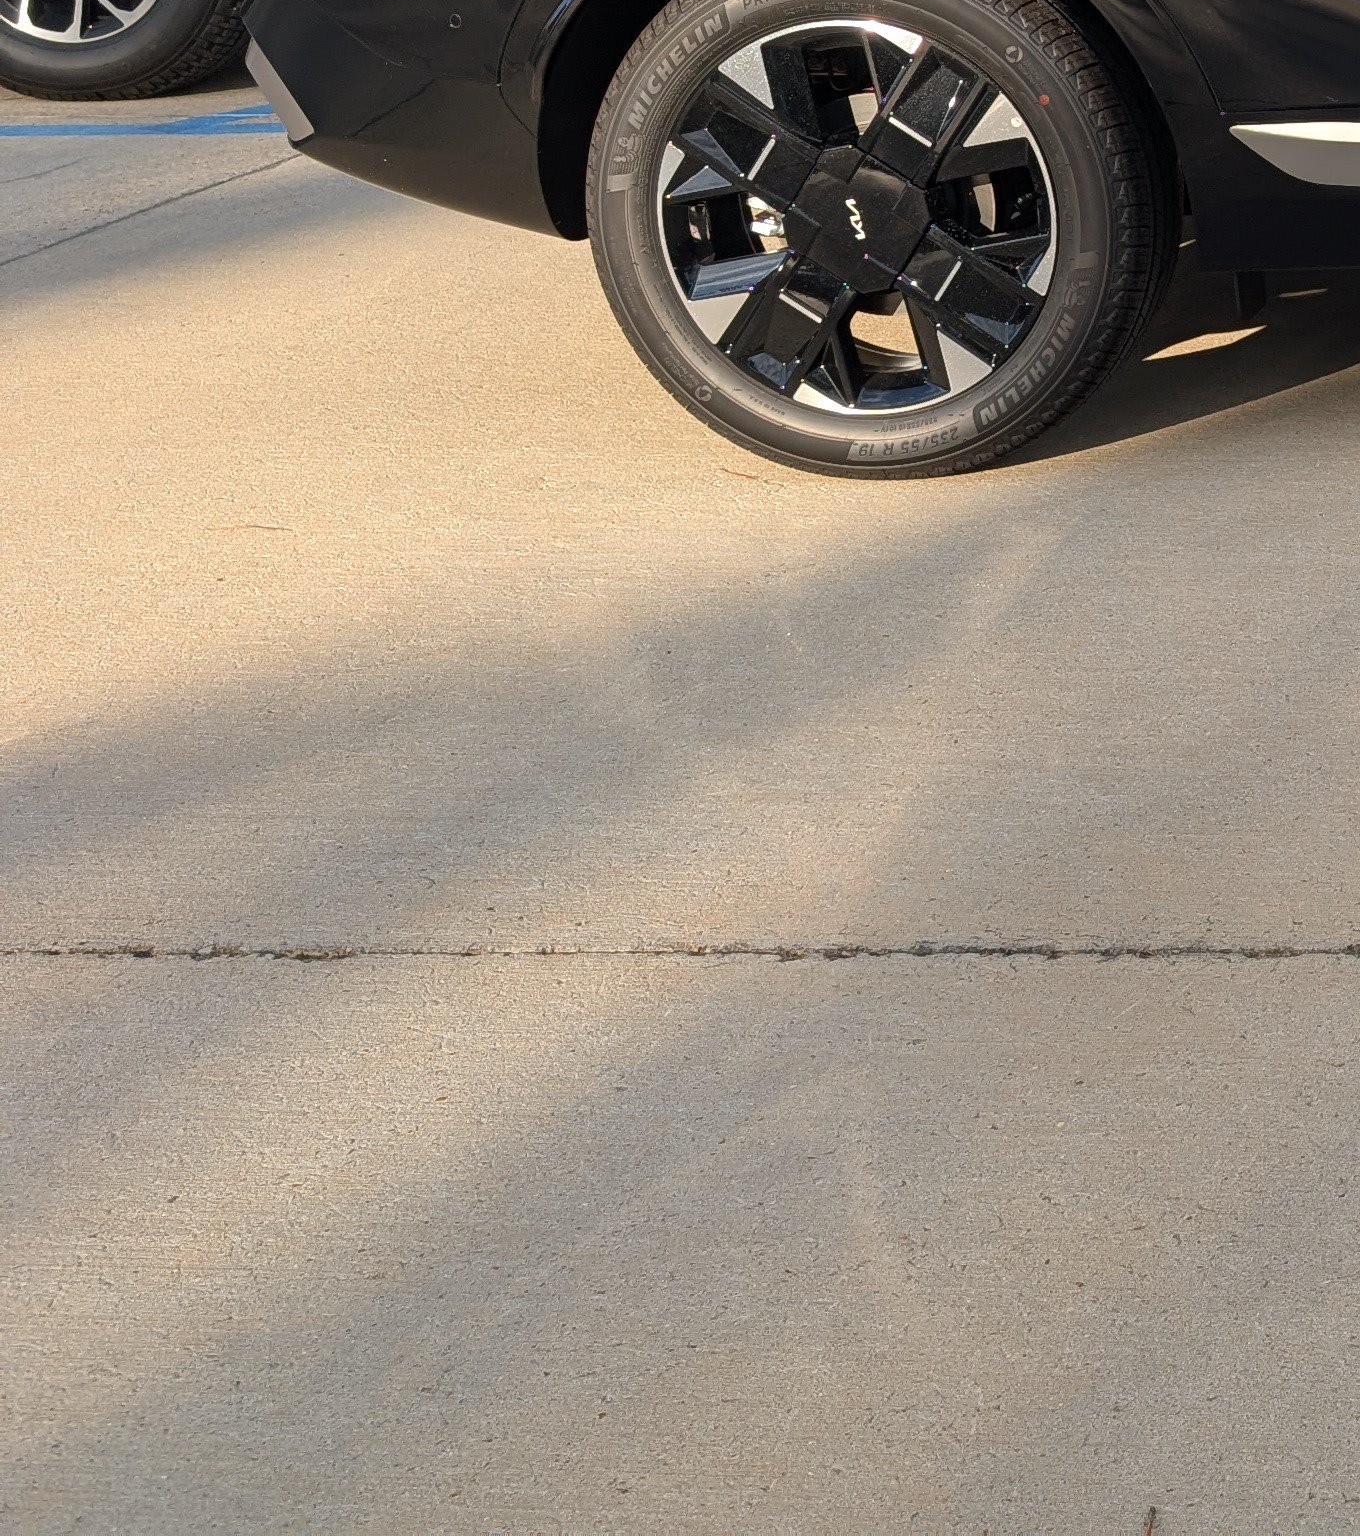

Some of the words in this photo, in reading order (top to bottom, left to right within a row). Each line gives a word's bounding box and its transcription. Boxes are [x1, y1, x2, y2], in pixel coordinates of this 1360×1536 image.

[628, 12, 724, 130] MICHELIN
[980, 313, 1076, 426] MICHELIN
[857, 441, 875, 457] 19
[882, 441, 894, 457] R
[901, 425, 960, 456] 235/55
